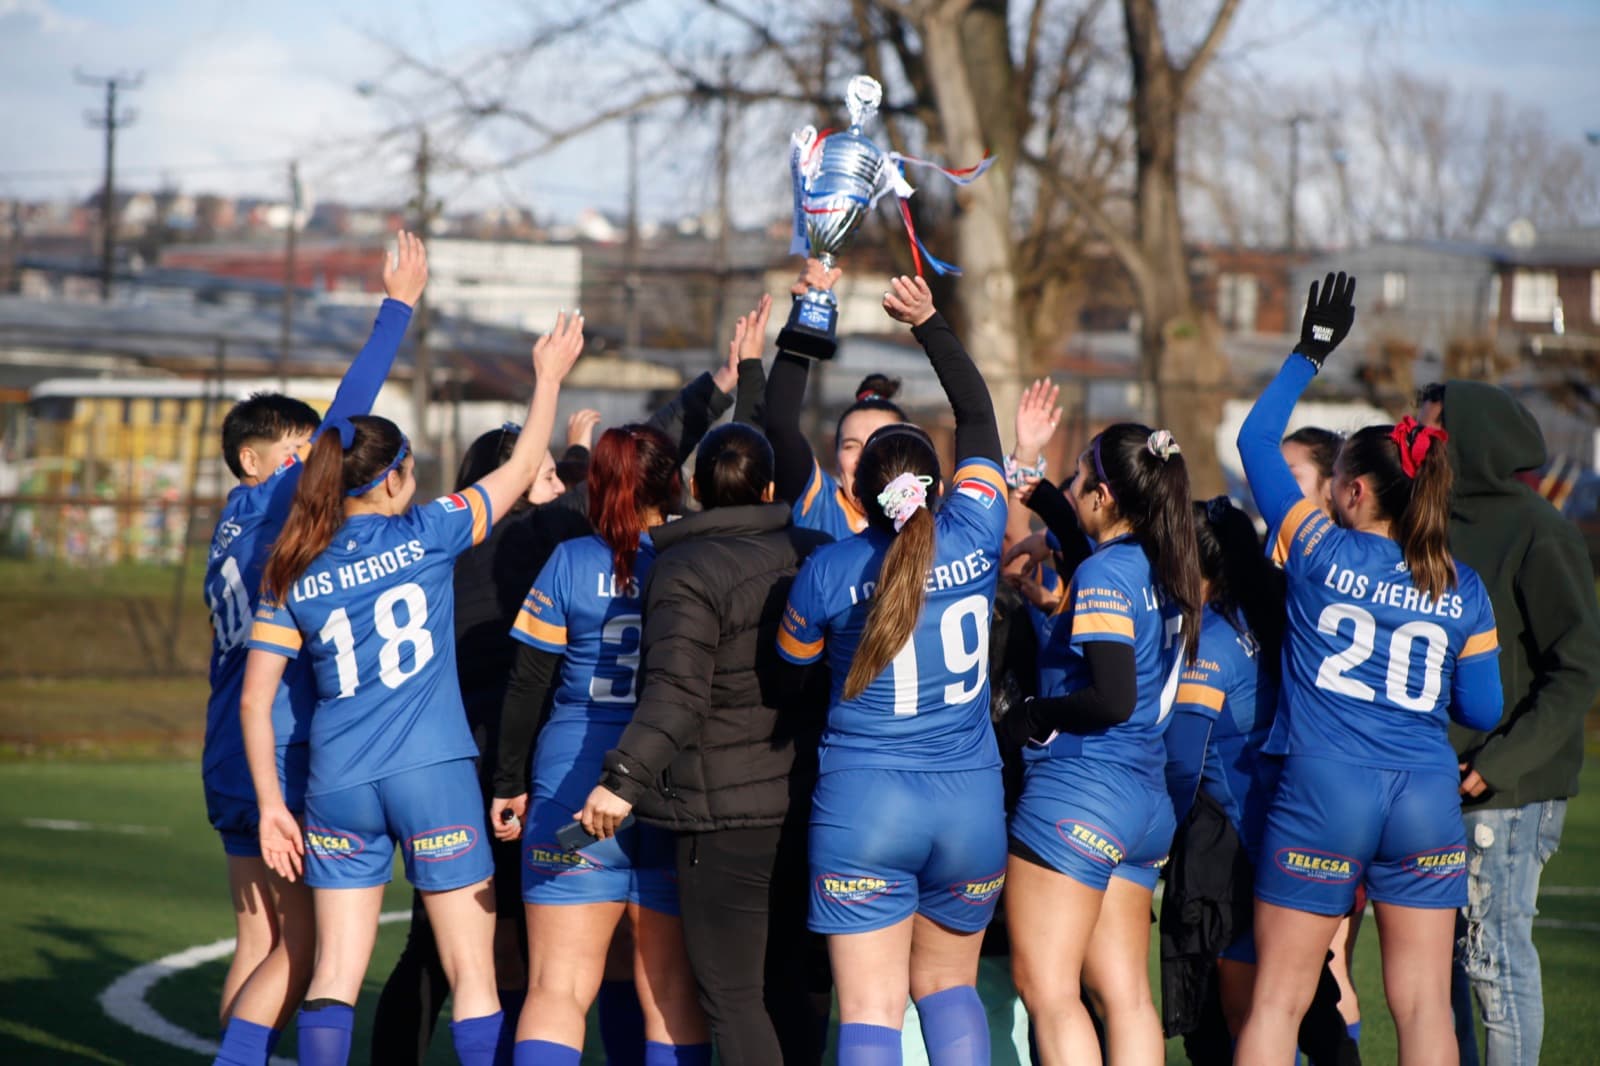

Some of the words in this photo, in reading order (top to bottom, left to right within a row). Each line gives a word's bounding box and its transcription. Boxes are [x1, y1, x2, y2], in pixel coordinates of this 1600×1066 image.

[292, 572, 333, 603] LOS
[338, 539, 426, 590] HEROES
[923, 549, 992, 593] EROES
[1324, 563, 1369, 599] LOS
[1371, 580, 1464, 619] HEROES
[319, 582, 434, 699] 18
[892, 594, 990, 716] 19
[1315, 602, 1449, 713] 20
[412, 829, 469, 852] TELECSA
[1288, 851, 1351, 873] TELECSA
[1417, 851, 1466, 868] TELECSA
[823, 878, 887, 894] TELECSA
